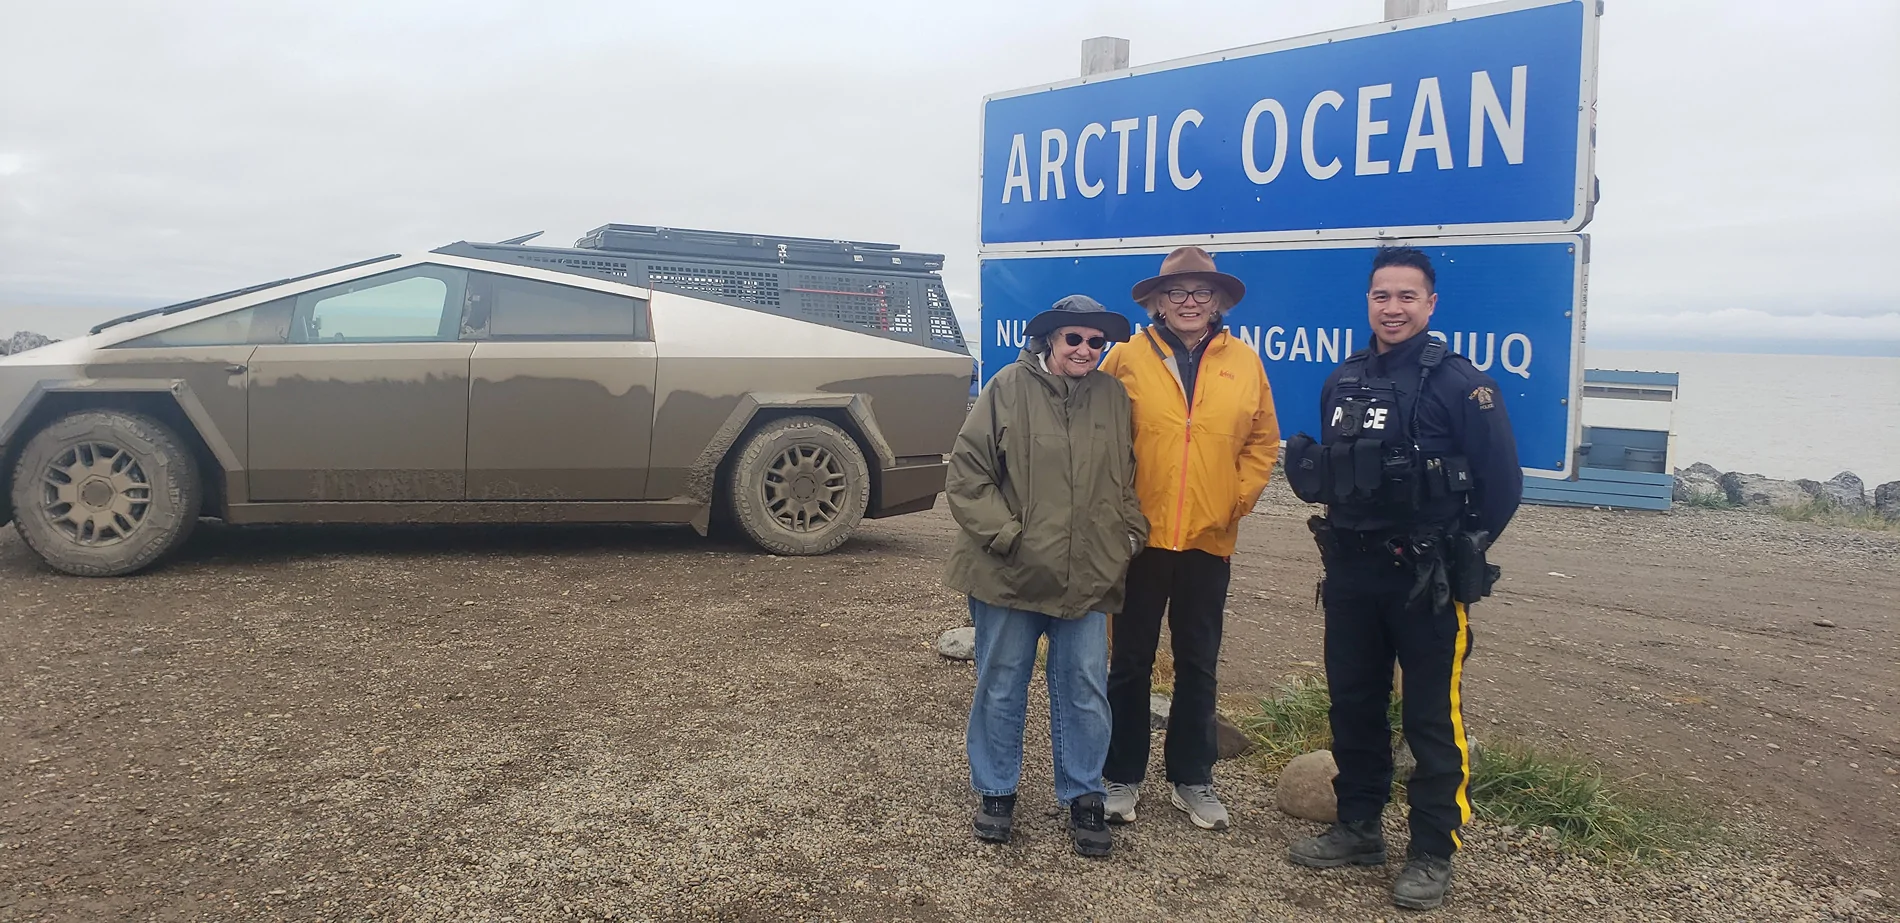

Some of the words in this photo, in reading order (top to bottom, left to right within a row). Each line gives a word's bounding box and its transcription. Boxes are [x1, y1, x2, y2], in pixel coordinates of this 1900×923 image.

[1001, 108, 1204, 204] ARCTIC
[1241, 65, 1527, 185] OCEAN
[1331, 406, 1388, 429] PCE
